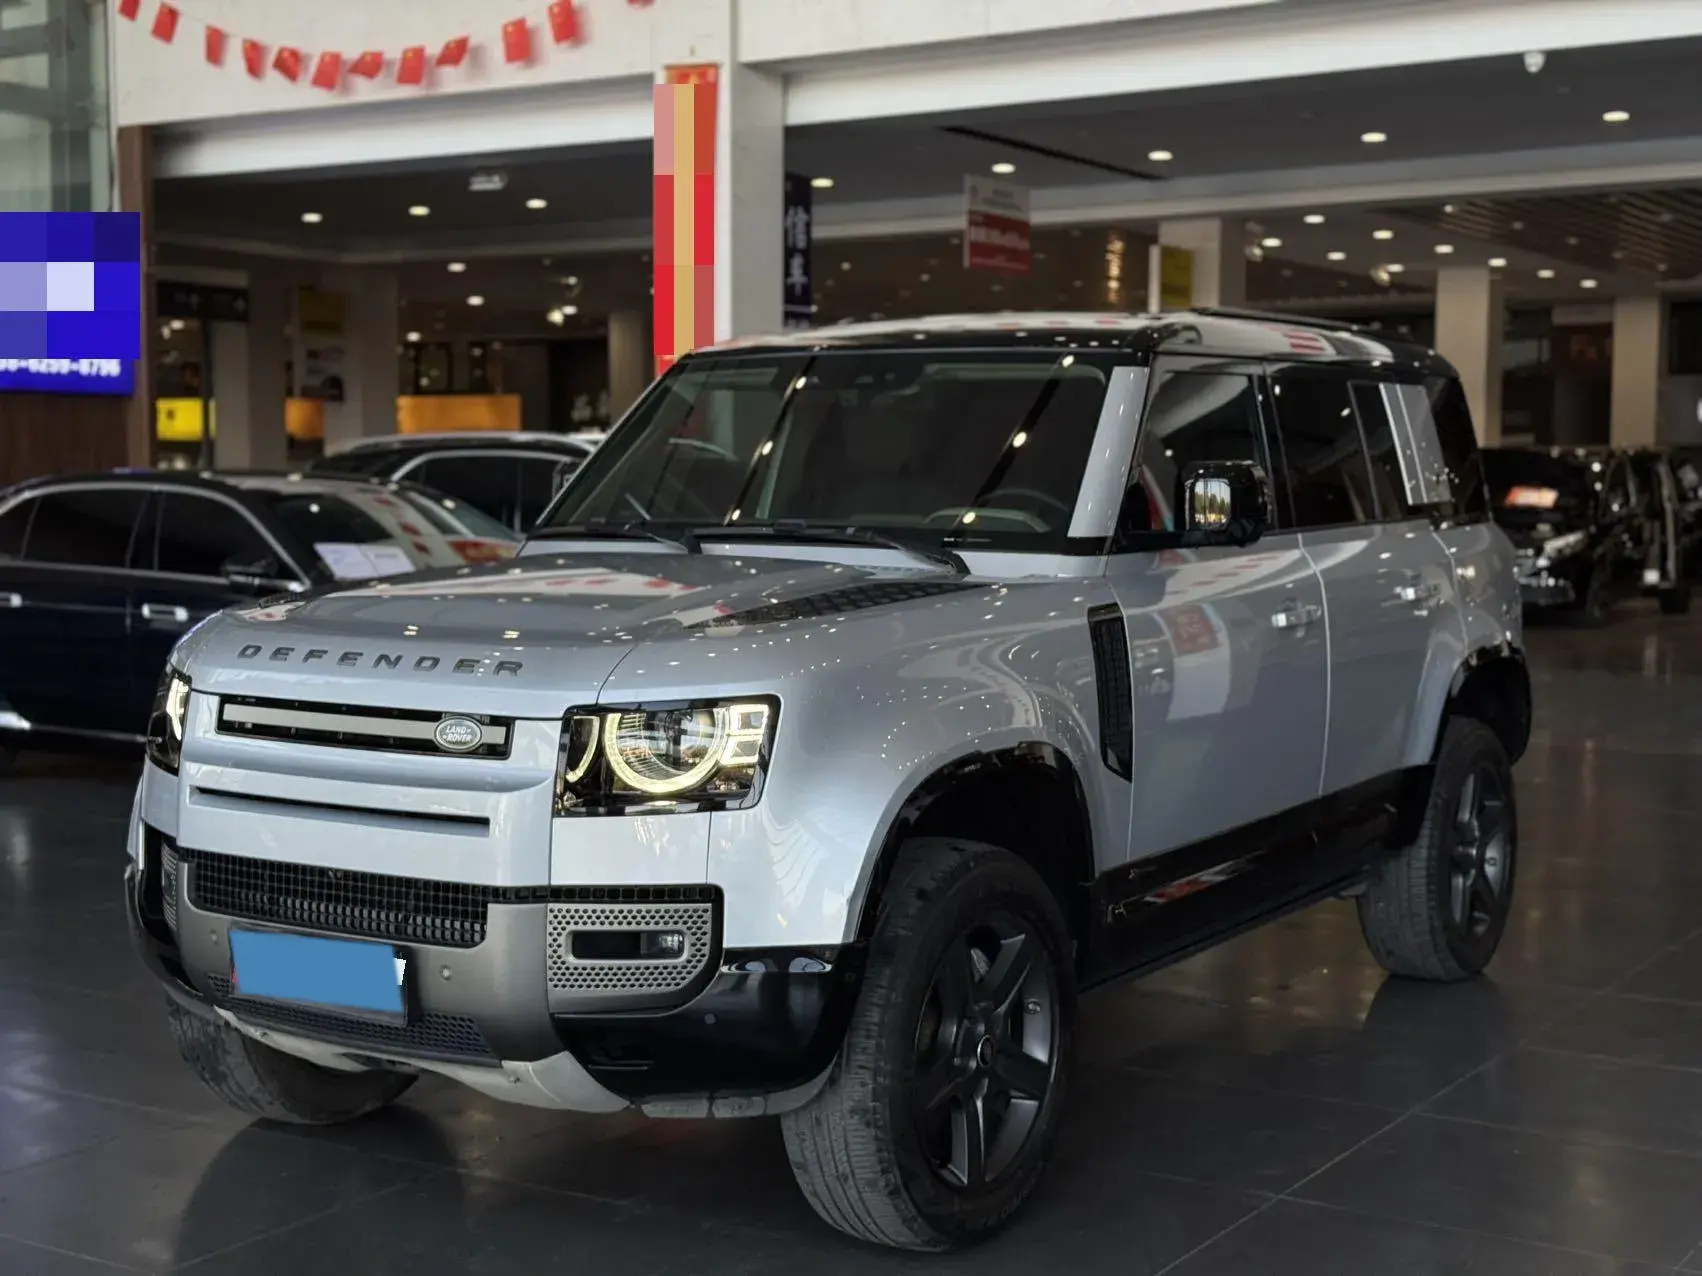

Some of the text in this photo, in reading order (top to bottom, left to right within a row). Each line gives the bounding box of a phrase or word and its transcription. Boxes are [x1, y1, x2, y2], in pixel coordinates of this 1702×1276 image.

[236, 644, 524, 677] DEFENDER
[446, 724, 467, 734] LAND
[446, 732, 473, 743] ROVER
